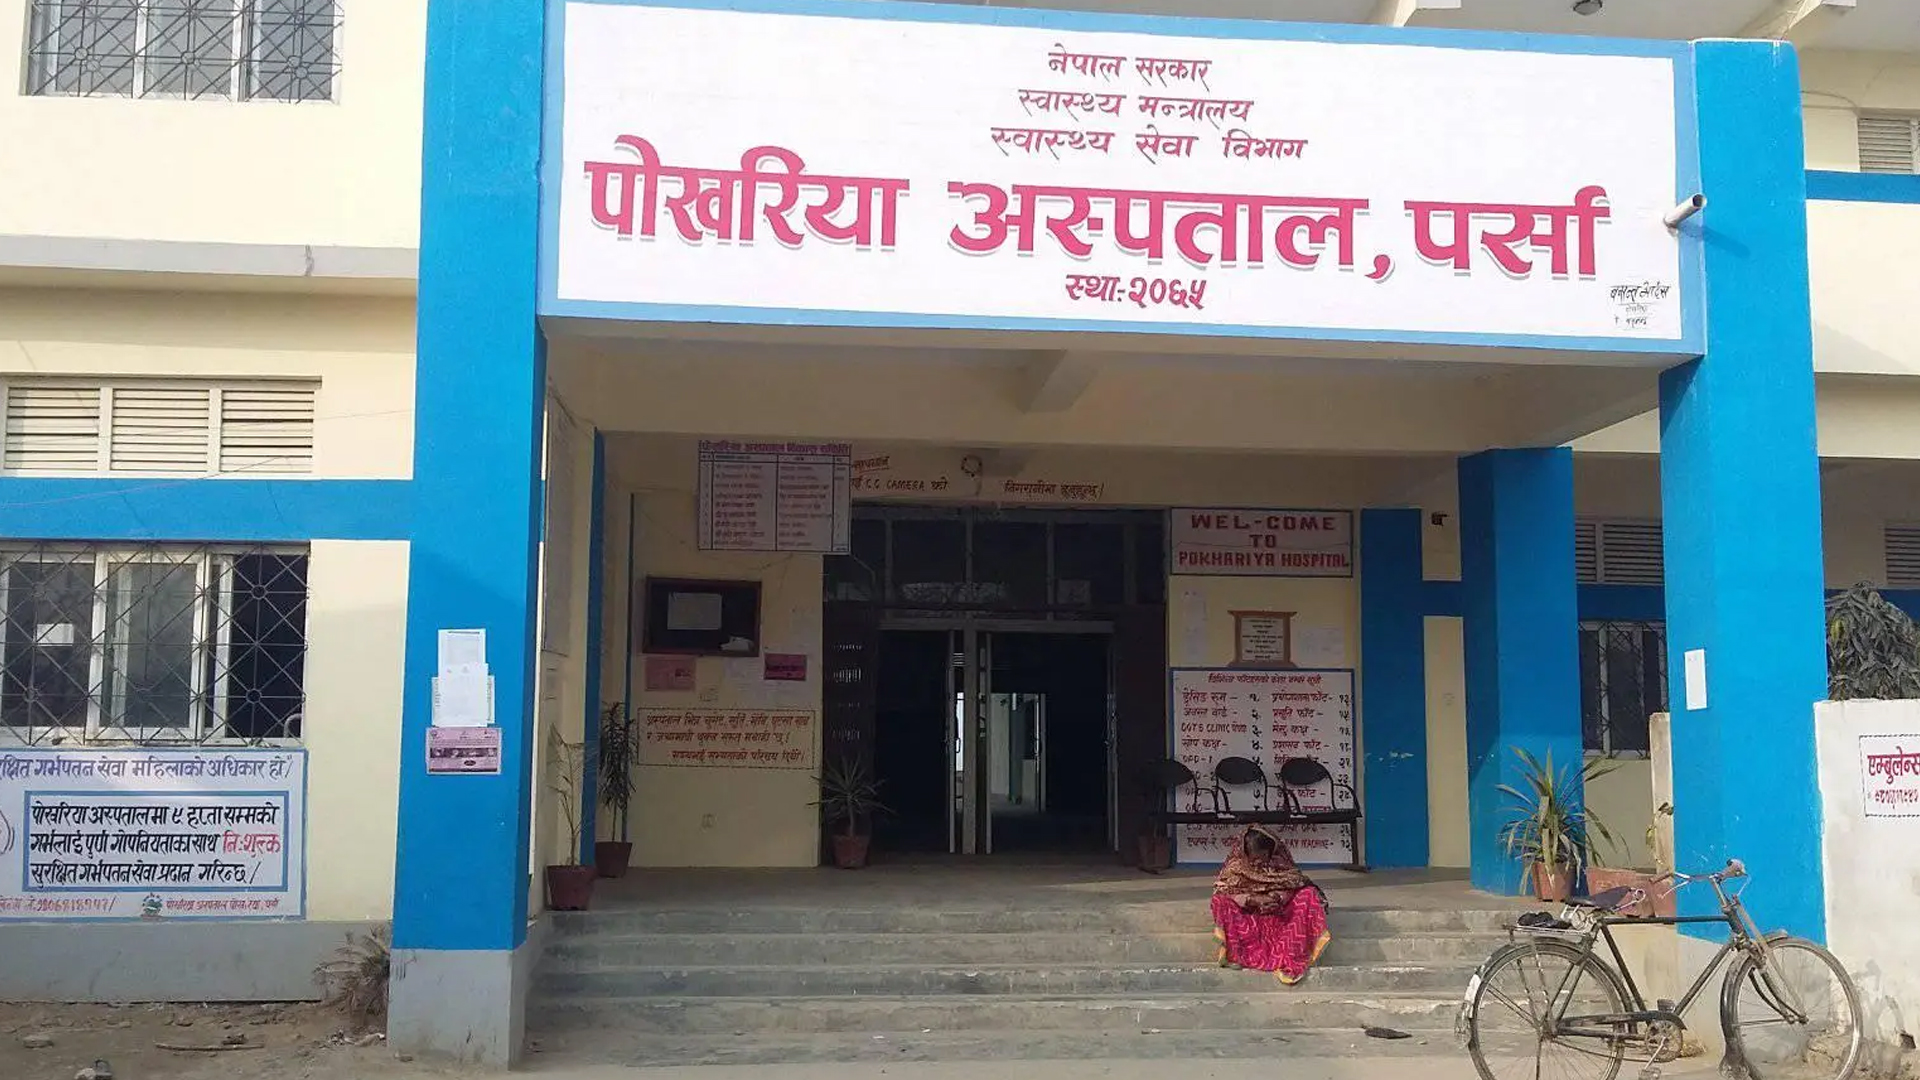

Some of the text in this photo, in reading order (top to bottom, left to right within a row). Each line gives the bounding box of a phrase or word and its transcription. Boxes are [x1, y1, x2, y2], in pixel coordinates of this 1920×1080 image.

[1049, 43, 1212, 91] नेपाल सरकार
[1018, 89, 1254, 128] स्वास्थ्य मन्त्रालय
[991, 125, 1307, 164] स्वास्थ्य सेवा विभाग
[584, 135, 1611, 284] पोखरिया अस्पताल, पर्सा
[886, 479, 925, 491] CAMERA
[1190, 514, 1336, 531] WEL-COME
[1249, 534, 1276, 548] TO
[1179, 551, 1351, 567] POKHARIYA HOSPITAL
[34, 755, 95, 777] गर्भपतन
[95, 756, 128, 779] सेवा
[132, 754, 206, 780] महिलाको
[207, 754, 266, 779] अधिकार
[32, 800, 91, 826] पोखरिया
[224, 801, 280, 826] सम्मको
[30, 829, 84, 856] गर्भलाई
[30, 859, 79, 888] सुरक्षित
[79, 859, 132, 884] गर्भपतन
[132, 860, 159, 884] सेवा
[157, 863, 194, 883] प्रदान
